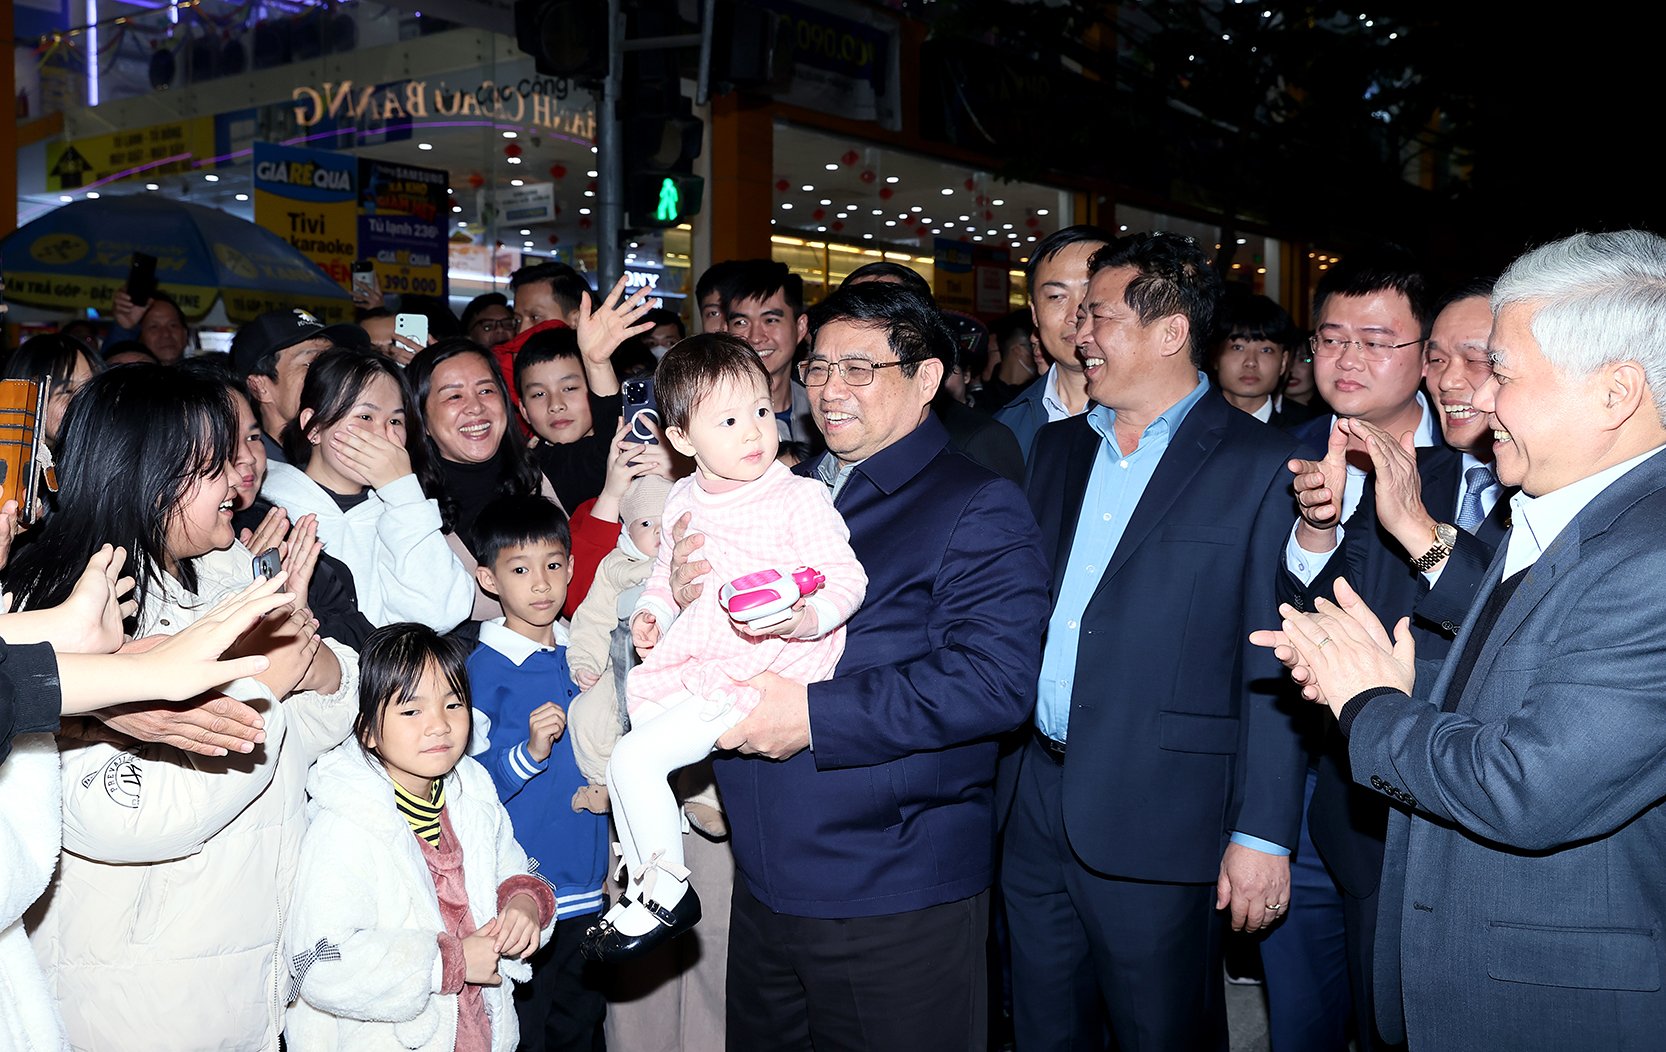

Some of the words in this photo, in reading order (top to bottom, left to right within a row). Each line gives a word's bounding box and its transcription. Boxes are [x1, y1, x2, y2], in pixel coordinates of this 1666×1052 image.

[287, 212, 325, 235] Tivi
[291, 235, 354, 255] karaoke
[624, 270, 660, 289] ONY
